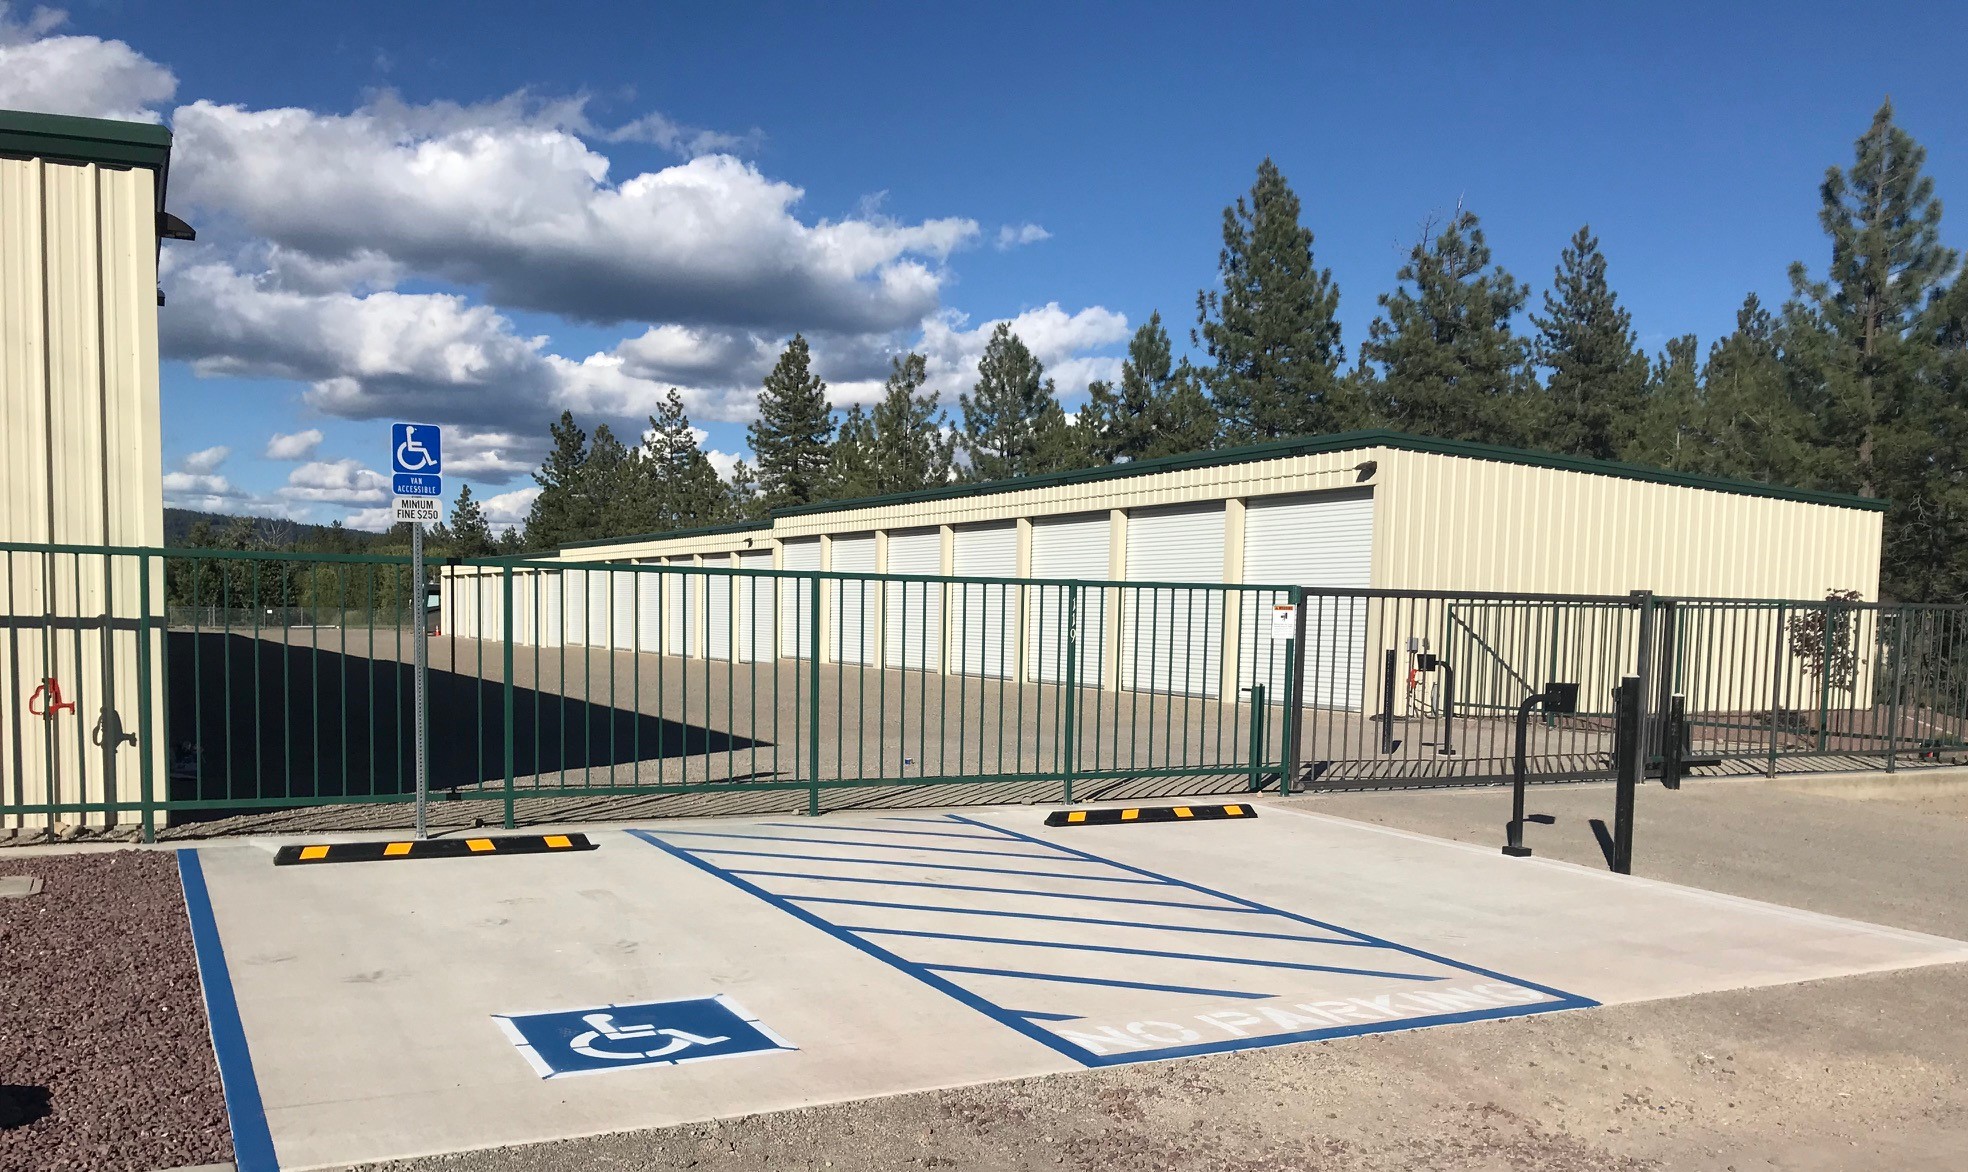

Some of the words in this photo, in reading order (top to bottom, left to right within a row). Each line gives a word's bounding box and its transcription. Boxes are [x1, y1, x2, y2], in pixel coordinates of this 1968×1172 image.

[410, 477, 423, 485] VAN
[397, 485, 436, 494] ACCESSIBLE
[397, 509, 415, 518] FINE
[417, 509, 438, 519] $250
[1055, 1020, 1200, 1054] NO
[1193, 982, 1544, 1036] PARKING
